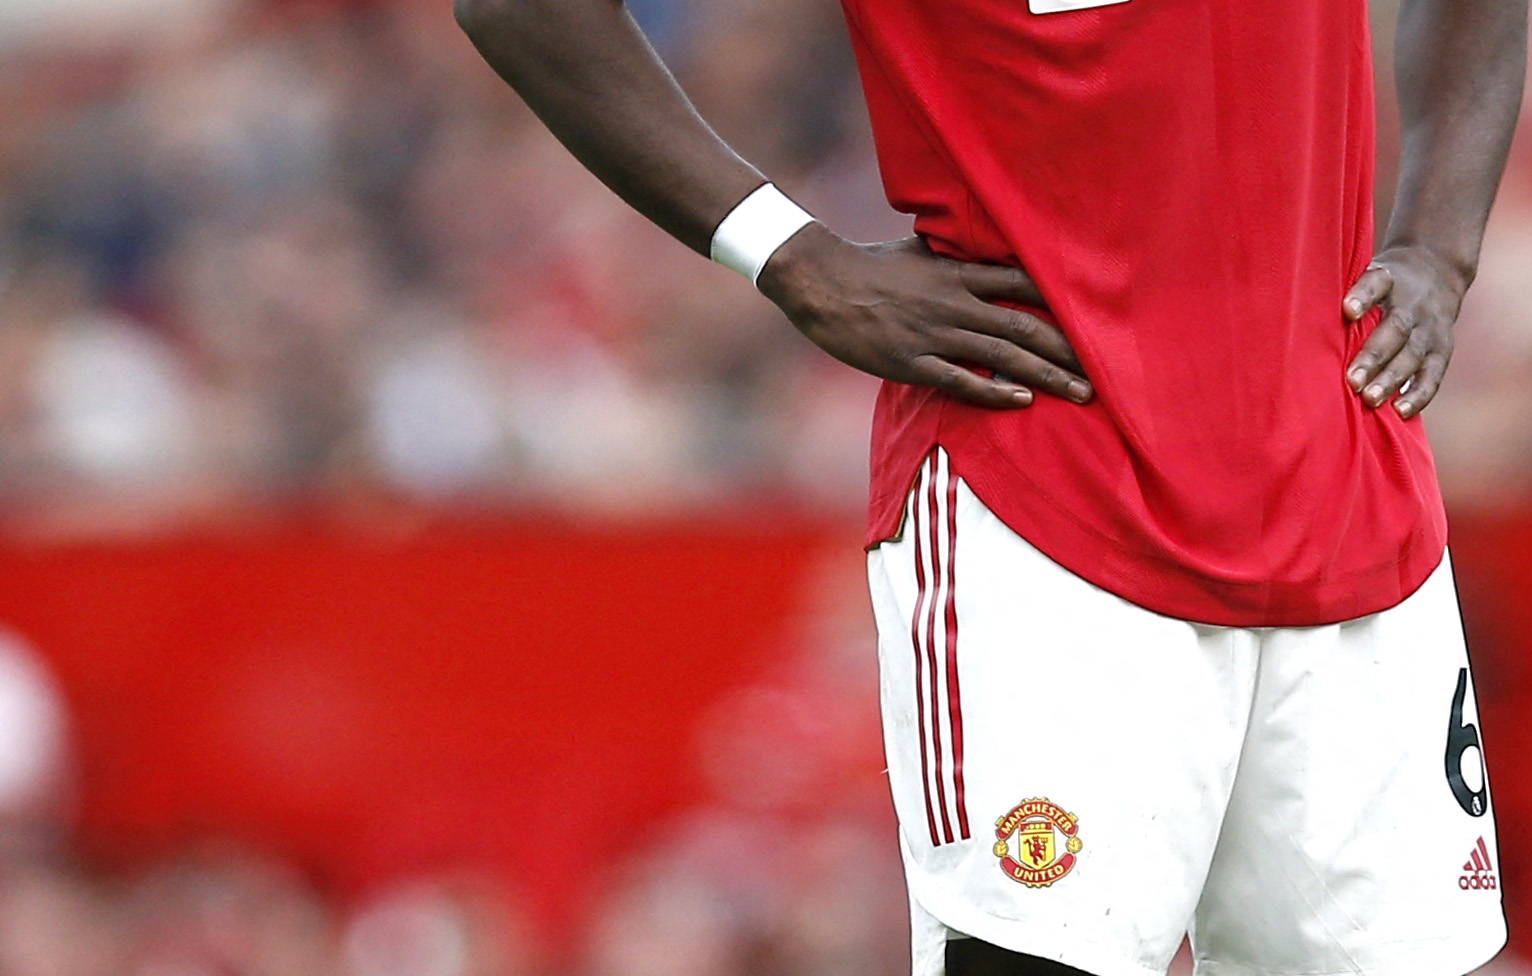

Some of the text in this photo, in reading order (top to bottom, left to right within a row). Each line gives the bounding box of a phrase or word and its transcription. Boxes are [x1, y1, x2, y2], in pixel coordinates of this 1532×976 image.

[1444, 667, 1487, 817] 6
[1001, 803, 1073, 834] MANCHESTER
[1014, 864, 1064, 882] UNITED
